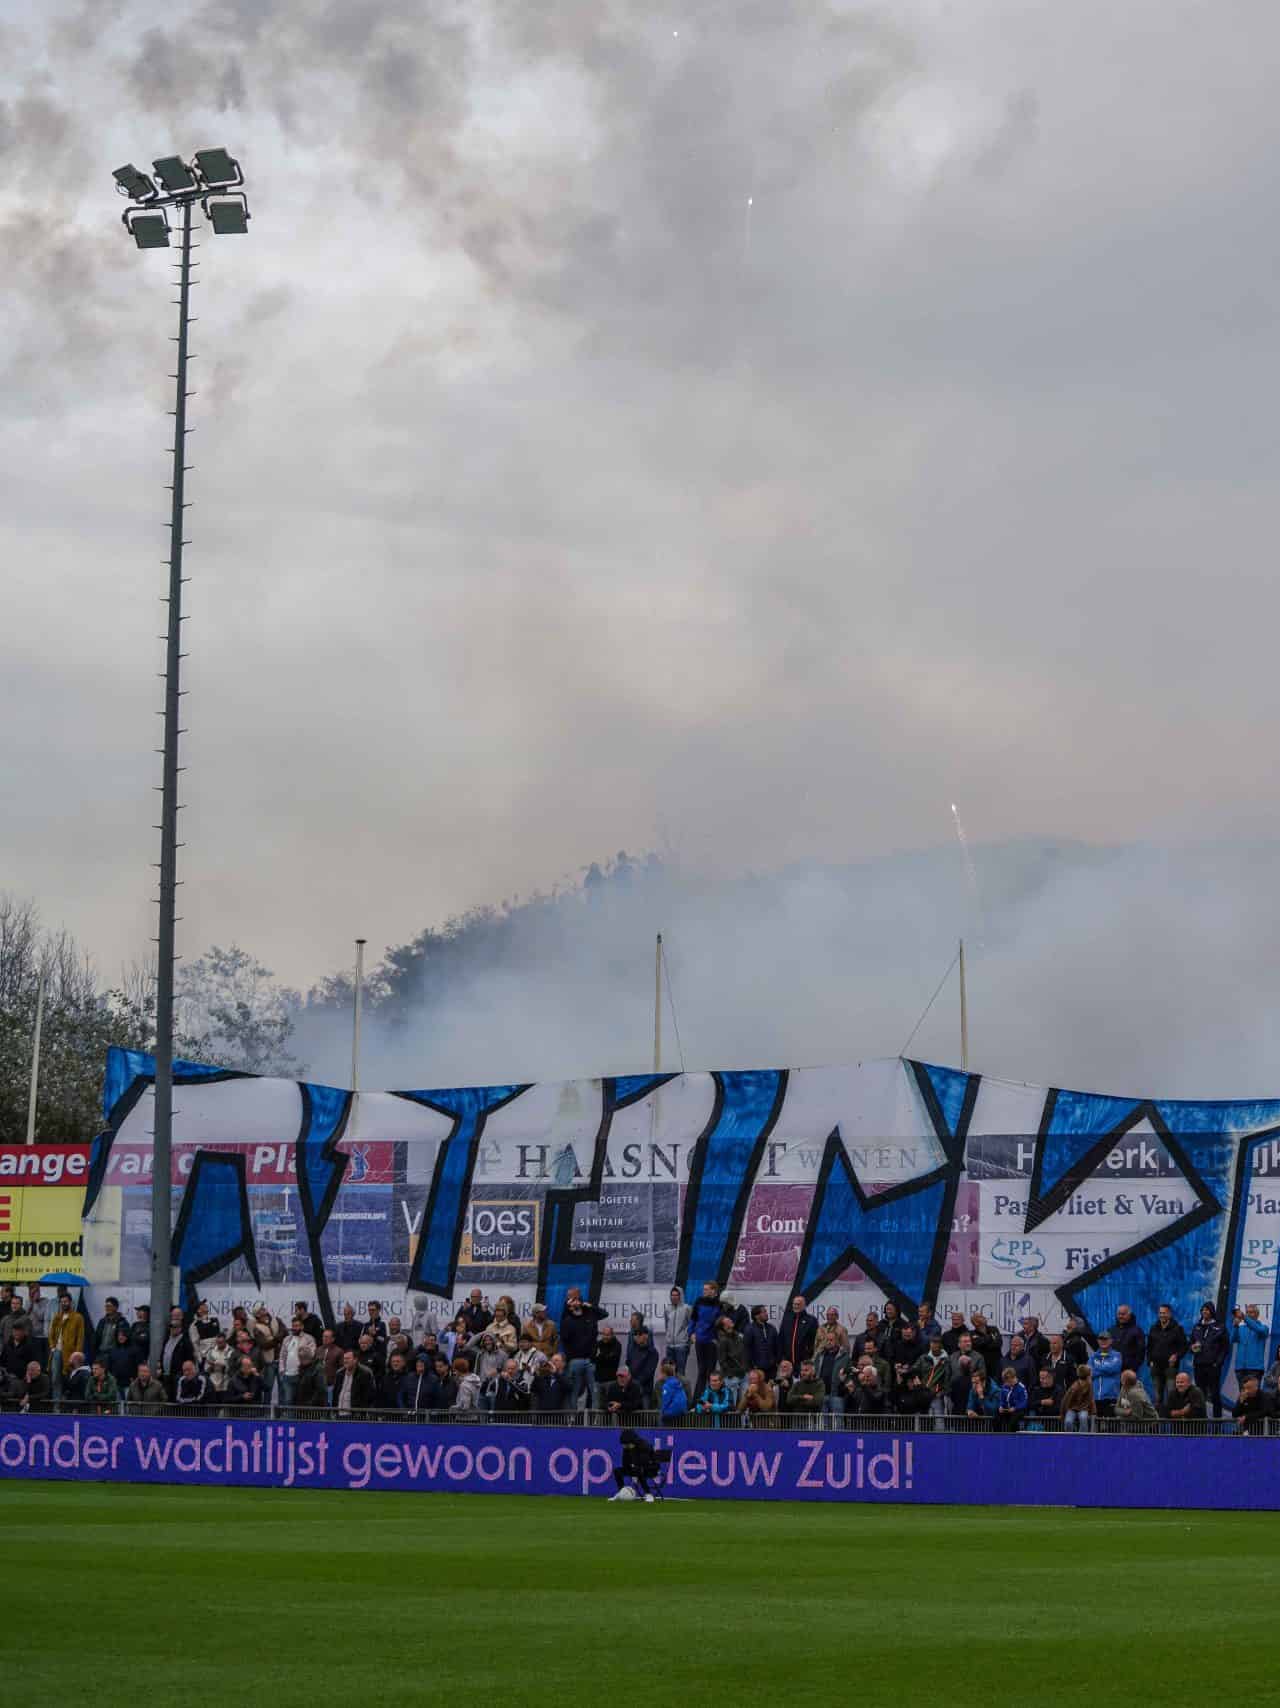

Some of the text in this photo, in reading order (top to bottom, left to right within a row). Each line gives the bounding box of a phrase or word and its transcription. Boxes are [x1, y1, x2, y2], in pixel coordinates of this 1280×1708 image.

[1113, 1195, 1136, 1216] &
[1140, 1195, 1185, 1216] Van
[579, 1217, 623, 1226] SANITAIR
[579, 1240, 652, 1249] DAKBEDEKKING
[1007, 1240, 1033, 1256] PP
[1247, 1239, 1274, 1255] PP
[0, 1421, 913, 1496] onder wachtlijst gewoon op ieuw Zuid!
